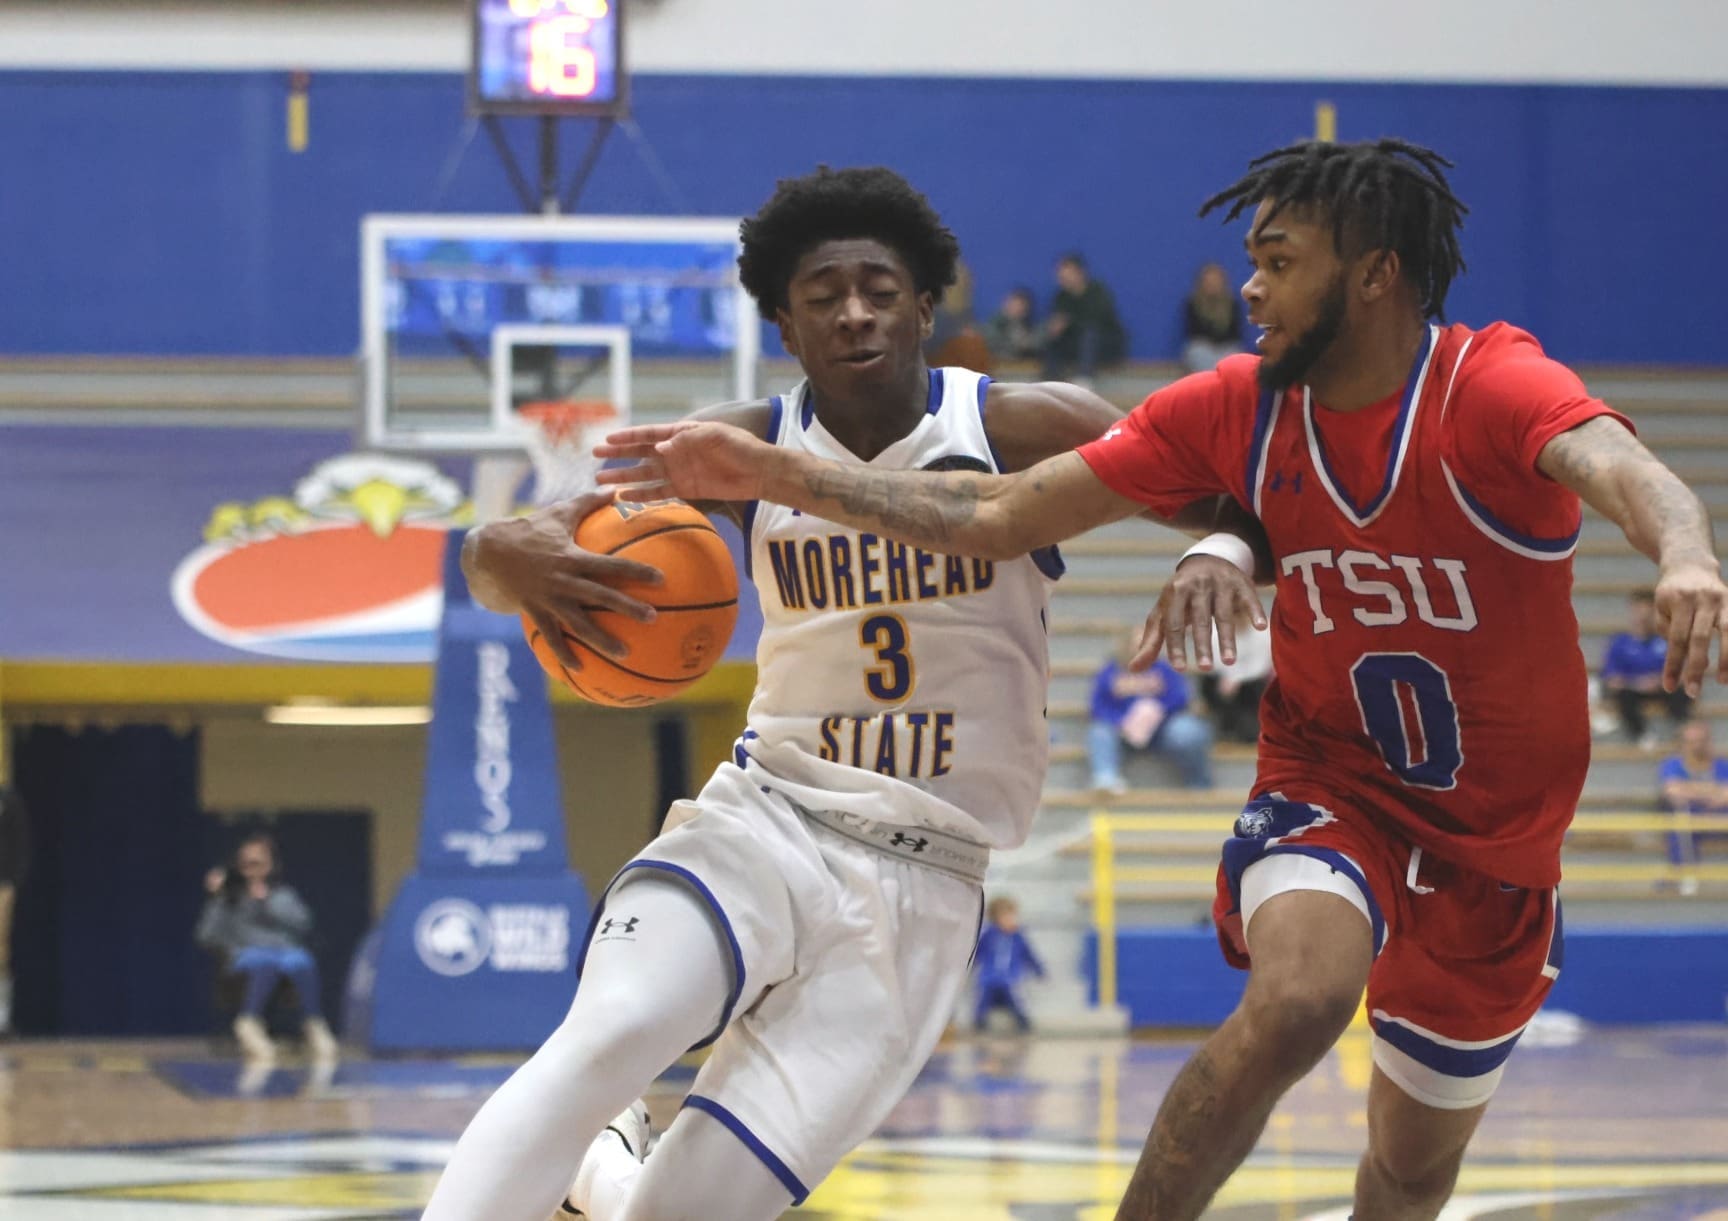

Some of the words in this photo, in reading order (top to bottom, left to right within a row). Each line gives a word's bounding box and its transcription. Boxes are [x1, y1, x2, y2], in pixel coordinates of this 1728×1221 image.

[528, 14, 597, 97] 16
[769, 534, 996, 612] MOREHEAD
[1281, 549, 1479, 636] TSU
[859, 611, 917, 704] 3
[819, 712, 957, 779] STATE
[1349, 651, 1465, 791] 0
